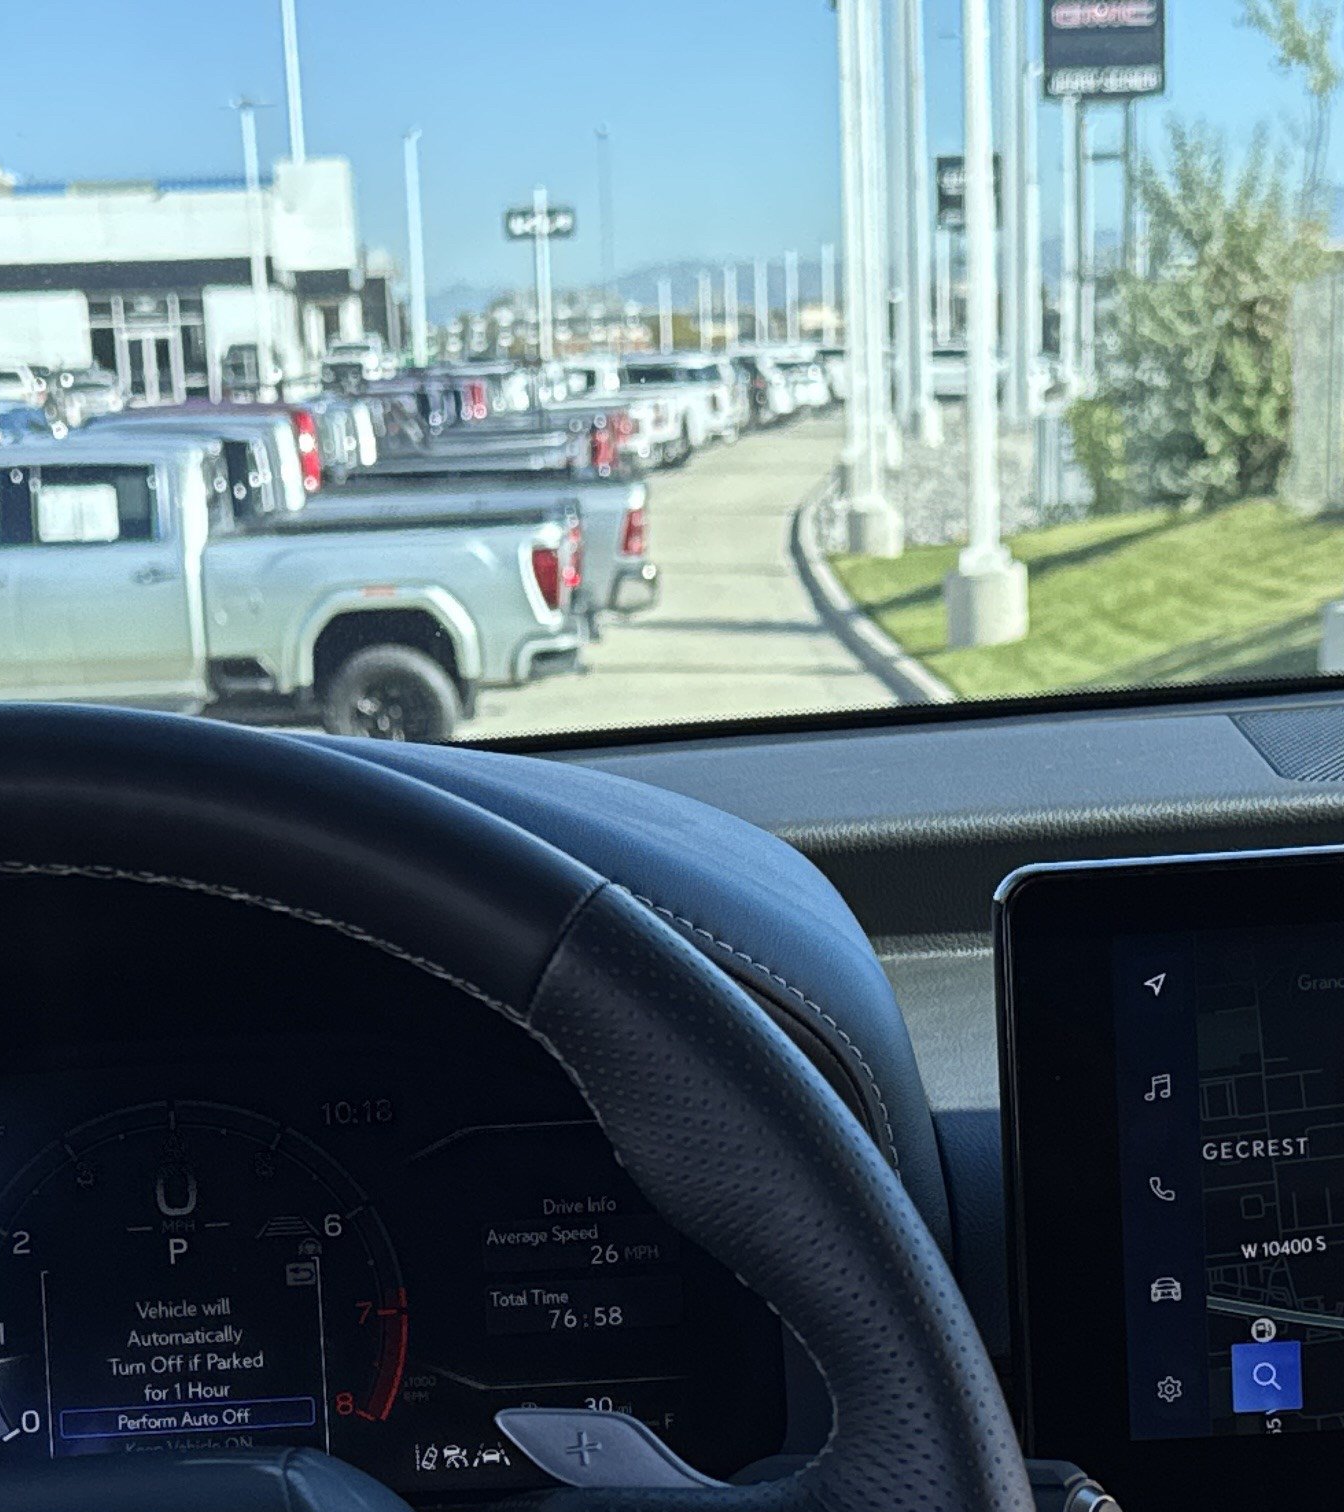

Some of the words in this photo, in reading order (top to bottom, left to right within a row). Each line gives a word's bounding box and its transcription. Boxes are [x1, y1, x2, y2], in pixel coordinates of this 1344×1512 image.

[320, 1098, 393, 1126] 10:18
[1202, 1137, 1310, 1161] GECREST
[543, 1199, 584, 1216] Drive
[587, 1196, 617, 1213] Info
[323, 1213, 343, 1238] 6
[485, 1228, 549, 1247] Average
[551, 1222, 599, 1245] Speed
[11, 1230, 32, 1255] 2
[168, 1237, 189, 1266] P
[590, 1244, 620, 1265] 26
[624, 1243, 660, 1262] MPH
[1241, 1244, 1257, 1259] W
[1261, 1239, 1313, 1257] 10400
[1316, 1236, 1327, 1252] S
[135, 1297, 198, 1321] Vehicle
[202, 1296, 232, 1317] will
[489, 1290, 528, 1308] Total
[530, 1288, 570, 1306] Time
[356, 1299, 373, 1326] 7
[126, 1325, 244, 1349] Automatically
[108, 1357, 146, 1377] Turn
[151, 1353, 185, 1376] Off
[188, 1353, 201, 1373] if
[206, 1349, 266, 1372] Parked
[144, 1383, 169, 1402] for
[173, 1383, 182, 1400] 1
[186, 1379, 232, 1400] Hour
[336, 1390, 355, 1417] 8
[21, 1409, 41, 1434] 0
[117, 1413, 178, 1432] Perform
[180, 1410, 219, 1429] Auto
[222, 1407, 252, 1426] Off
[665, 1412, 676, 1430] F
